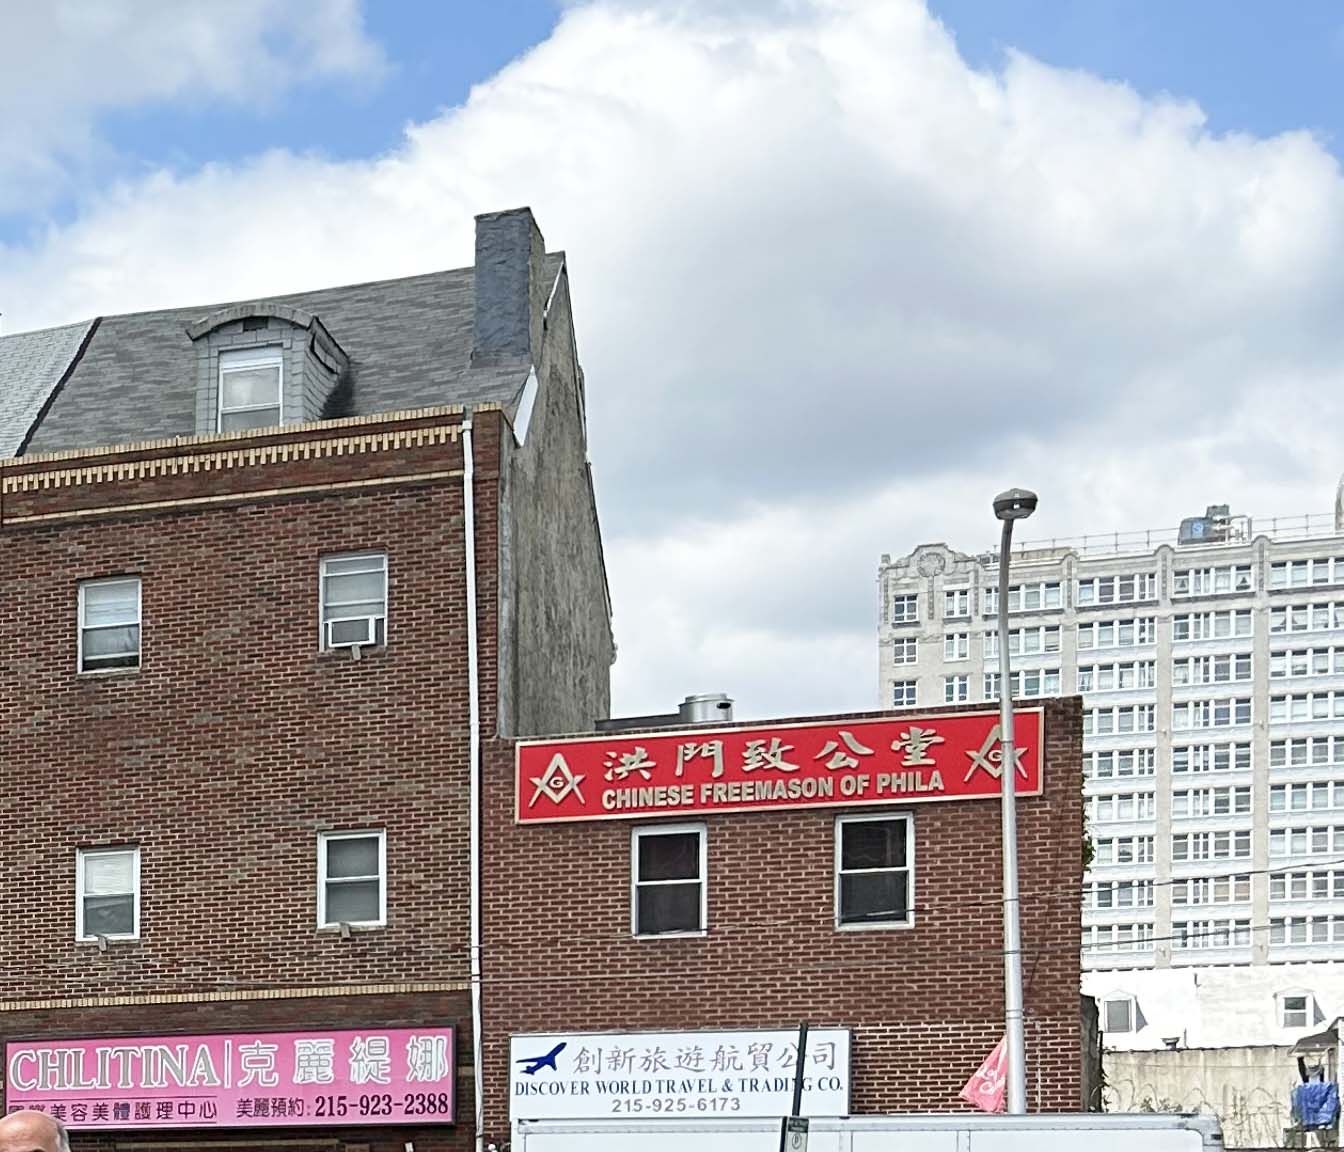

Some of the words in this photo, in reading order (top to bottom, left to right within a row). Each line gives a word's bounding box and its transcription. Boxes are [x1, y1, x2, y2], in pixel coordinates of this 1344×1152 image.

[603, 727, 944, 781] 洪門致公堂
[602, 784, 694, 810] CHINESE
[700, 776, 834, 804] FREEMASON
[840, 774, 869, 795] OF
[877, 769, 945, 794] PHILA
[10, 1044, 218, 1091] CHLITINA
[515, 1078, 590, 1096] DISCOVER
[596, 1079, 652, 1095] WORLD
[654, 1077, 718, 1093] TRAVEL
[721, 1078, 733, 1093] &
[738, 1077, 813, 1093] TRADIG
[817, 1076, 845, 1091] CO.
[314, 1094, 449, 1118] 215-923-2388
[611, 1097, 741, 1114] 215-925-6173
